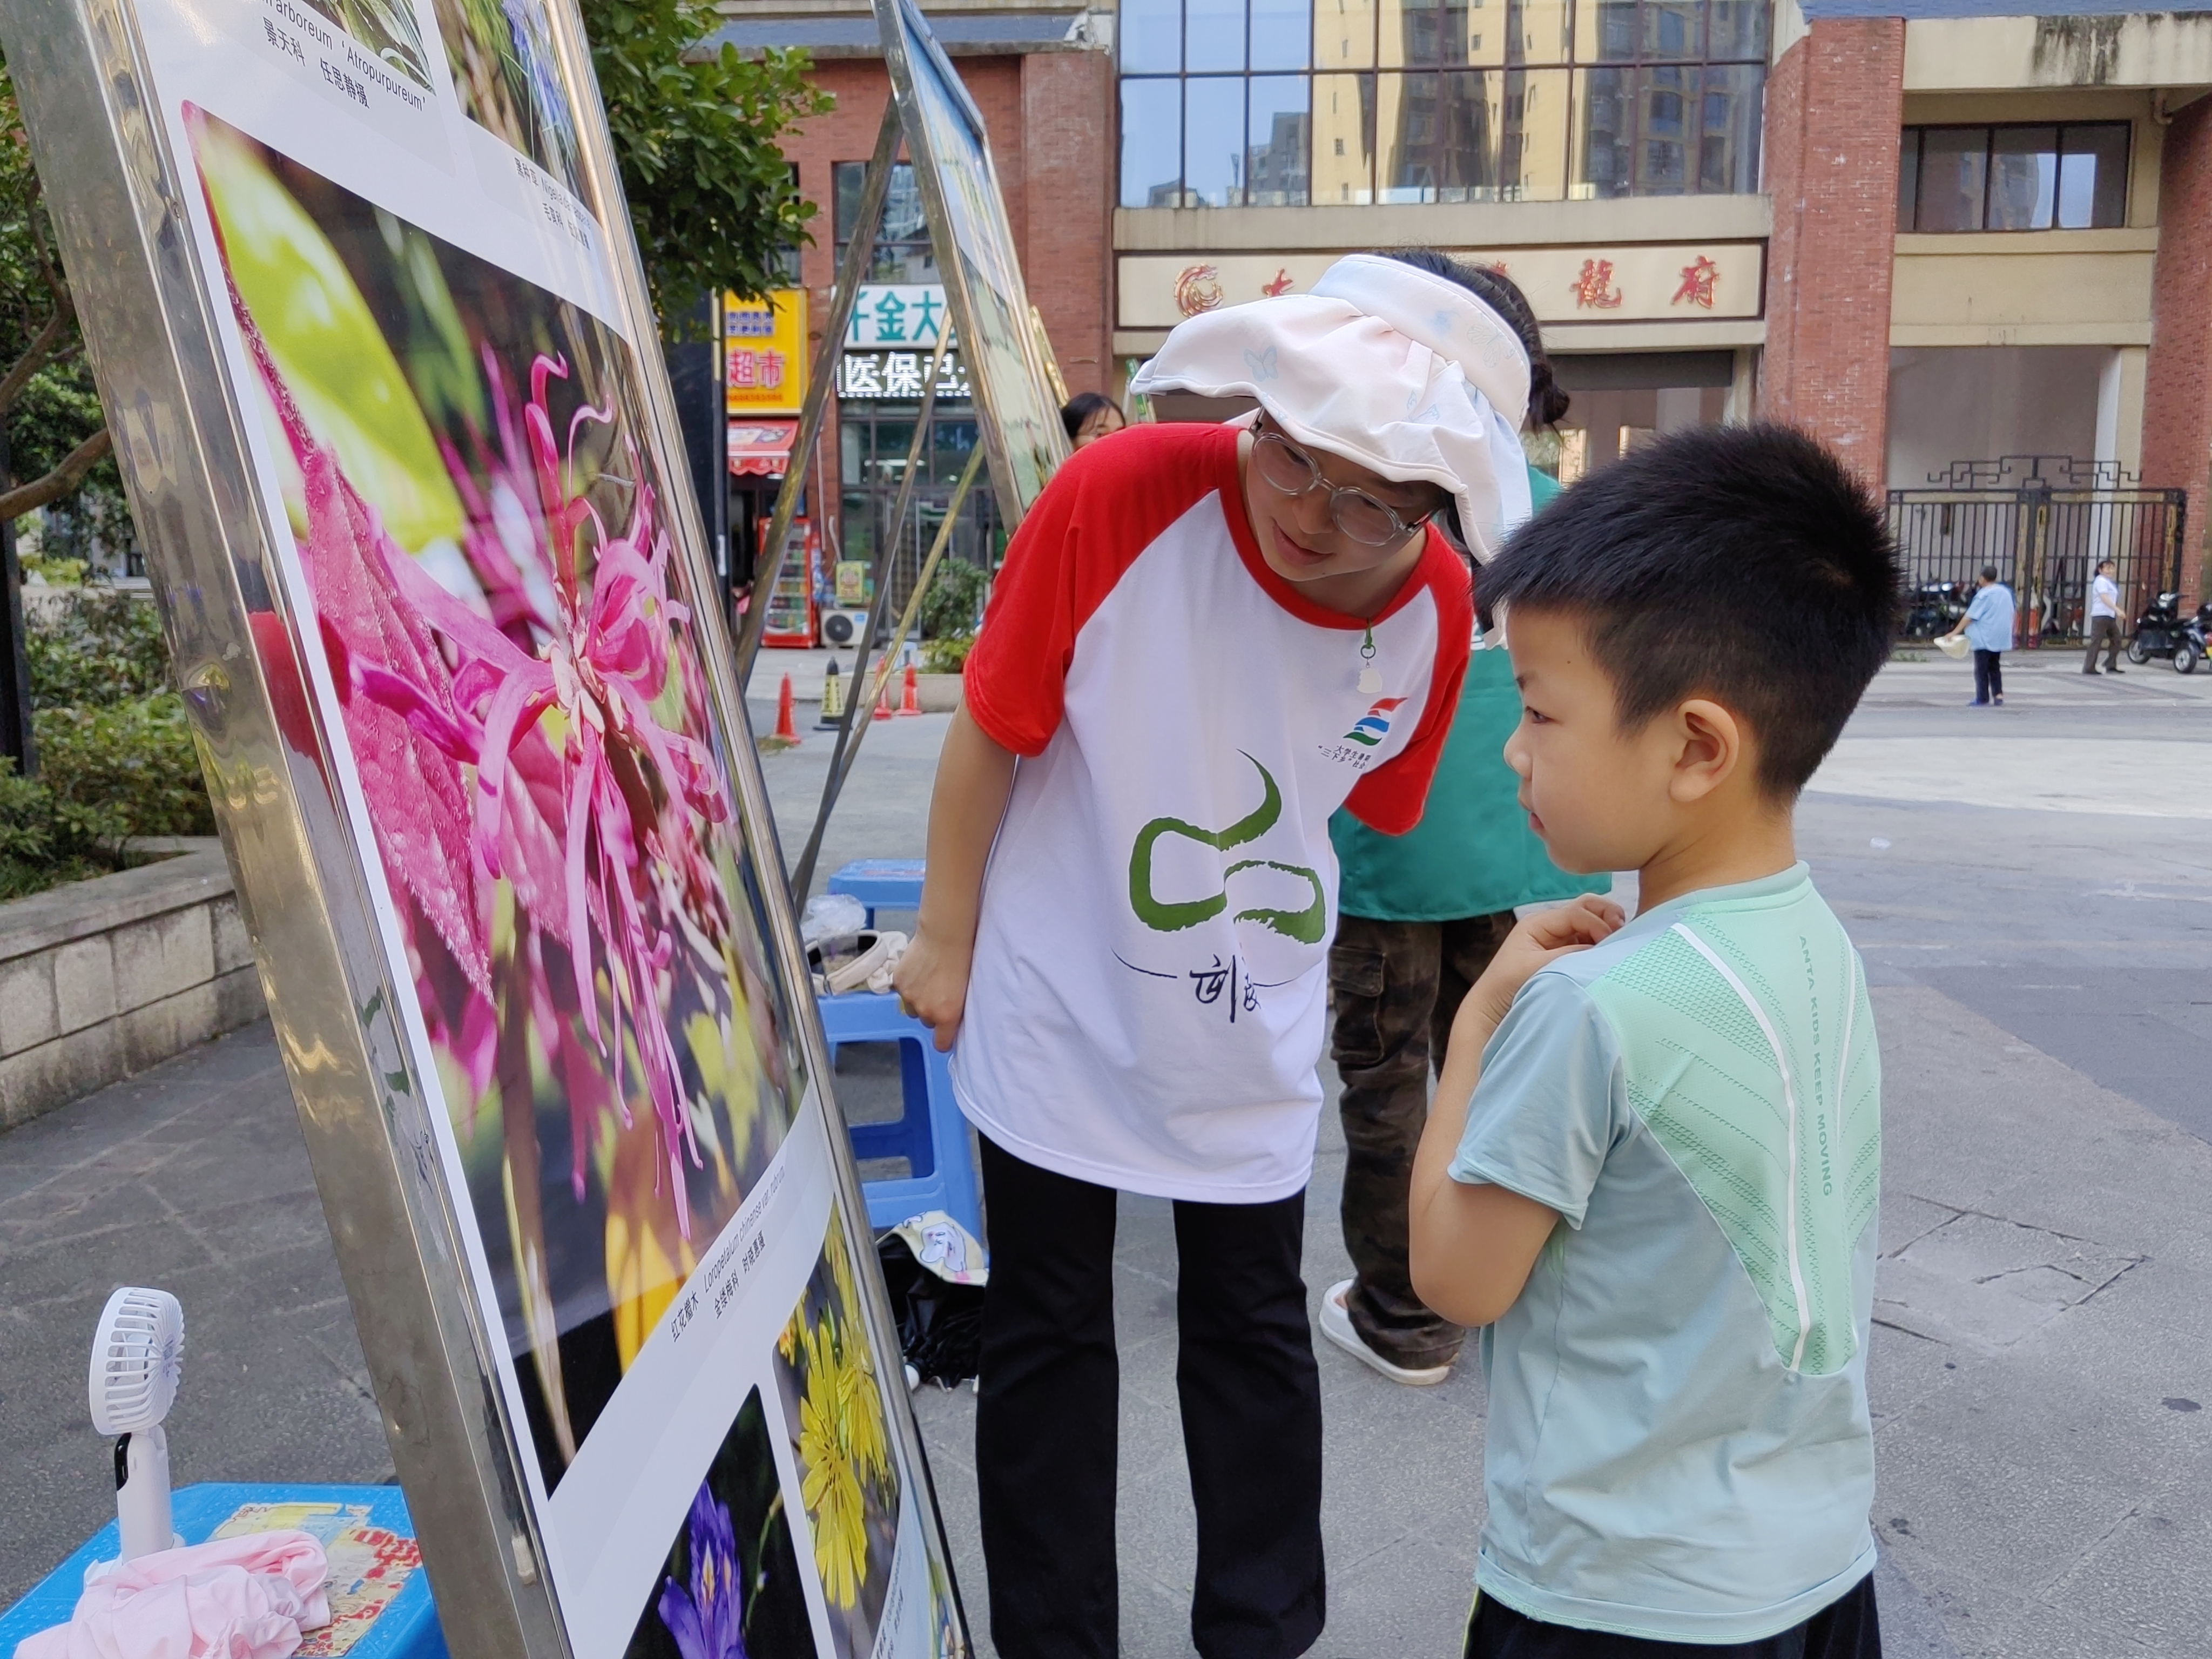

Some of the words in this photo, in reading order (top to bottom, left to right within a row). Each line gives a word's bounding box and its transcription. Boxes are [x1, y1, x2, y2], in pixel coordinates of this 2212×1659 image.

[276, 0, 333, 50] arboreum
[263, 16, 305, 67] 景天科
[320, 57, 370, 109] 任思静摄
[726, 347, 786, 389] 超市
[1799, 935, 1815, 990] ANTA
[1810, 996, 1820, 1046] KIDS
[1813, 1051, 1824, 1107] KEEP
[1817, 1112, 1832, 1197] MOVING
[703, 1233, 740, 1293] Loropetalum
